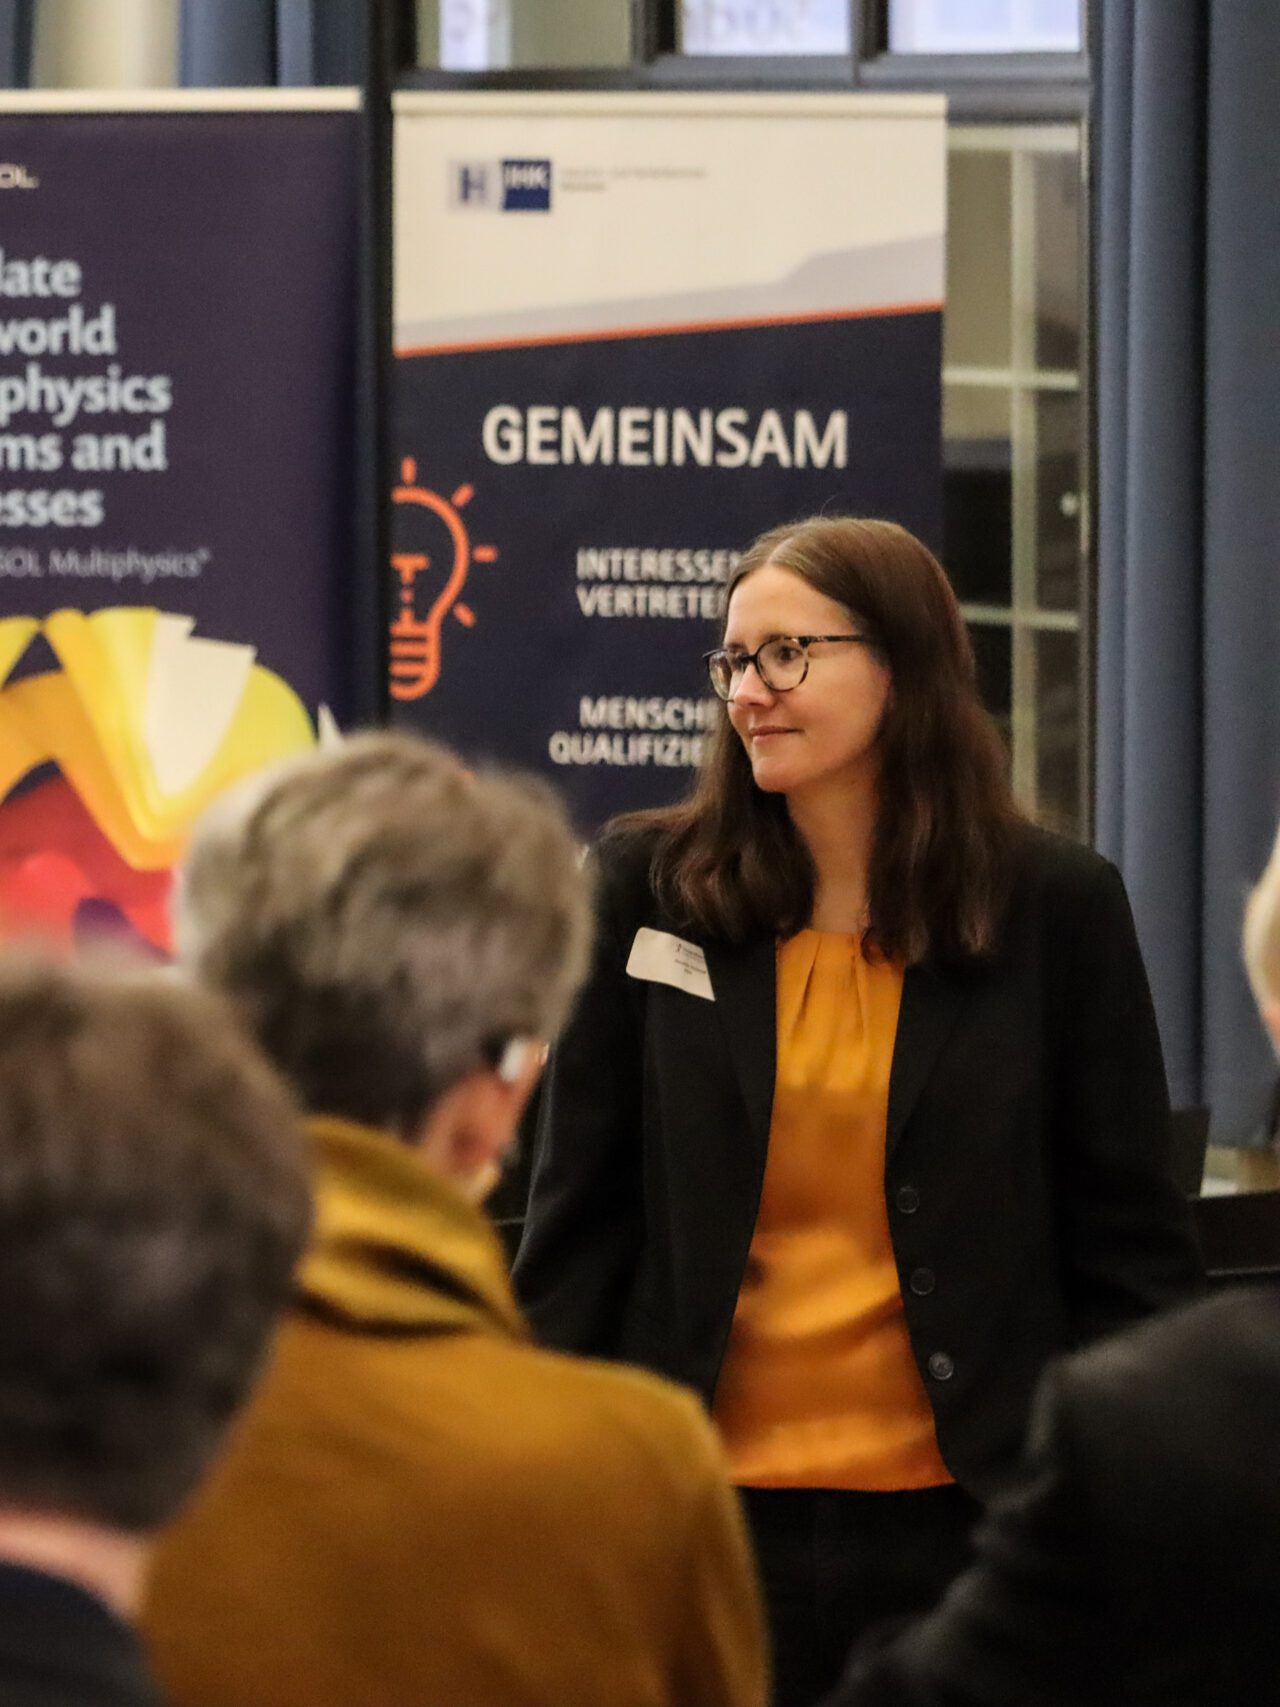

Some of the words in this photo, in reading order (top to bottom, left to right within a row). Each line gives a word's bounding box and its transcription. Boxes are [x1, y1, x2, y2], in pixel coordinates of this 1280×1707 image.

[71, 419, 168, 472] and
[482, 404, 849, 470] GEMEINSAM
[549, 731, 704, 768] QUALIFIZIE
